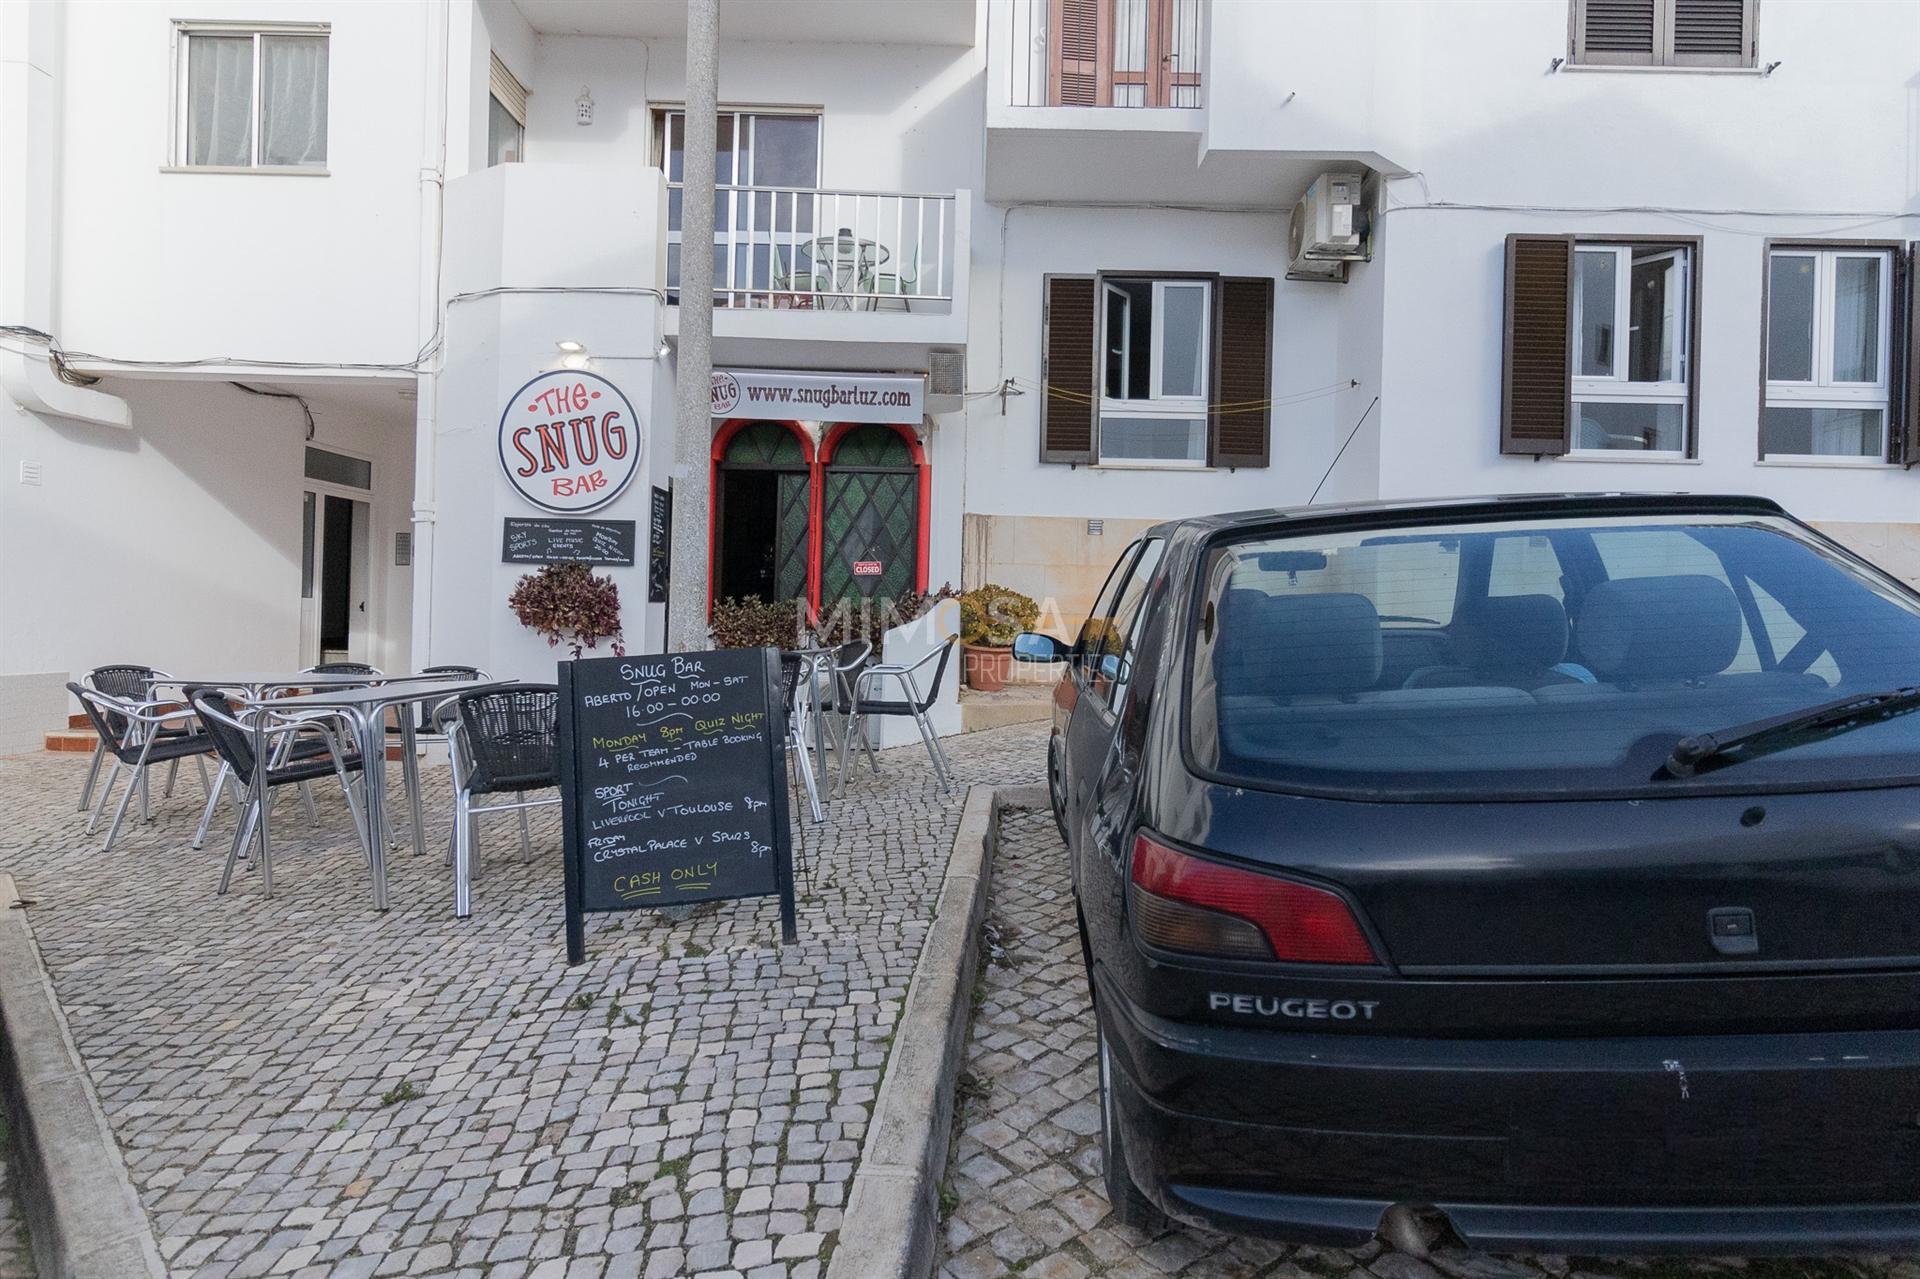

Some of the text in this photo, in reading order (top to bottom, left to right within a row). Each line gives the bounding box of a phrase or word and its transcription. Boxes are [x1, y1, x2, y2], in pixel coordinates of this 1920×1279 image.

[711, 382, 736, 403] NUG
[747, 384, 911, 408] www.snugbarluz.com
[513, 411, 627, 477] SNUG
[551, 470, 608, 496] BAR
[509, 539, 537, 551] SPORTS
[510, 531, 527, 542] SKY
[620, 656, 705, 680] SNUG BAR
[691, 680, 710, 690] MON
[723, 676, 748, 686] SAT
[592, 732, 647, 749] MONDAY
[695, 718, 726, 731] QUIZ
[731, 712, 765, 725] NIGHT
[599, 756, 610, 768] 4
[615, 754, 636, 764] PER
[639, 747, 669, 758] TEAM
[683, 738, 718, 751] TABLE
[723, 732, 762, 744] BOOKING
[627, 752, 697, 773] RECOMMENDED
[594, 783, 633, 799] SPORT
[602, 792, 664, 813] TONIGHT
[592, 812, 651, 830] LIVERPOOL
[666, 801, 733, 815] TOULOUSE
[587, 835, 625, 848] FRIDAY
[594, 845, 647, 862] CRYSTAL
[647, 839, 687, 851] PALACE
[614, 862, 717, 892] CASH ONLY
[1209, 991, 1380, 1020] PEUGEOT
